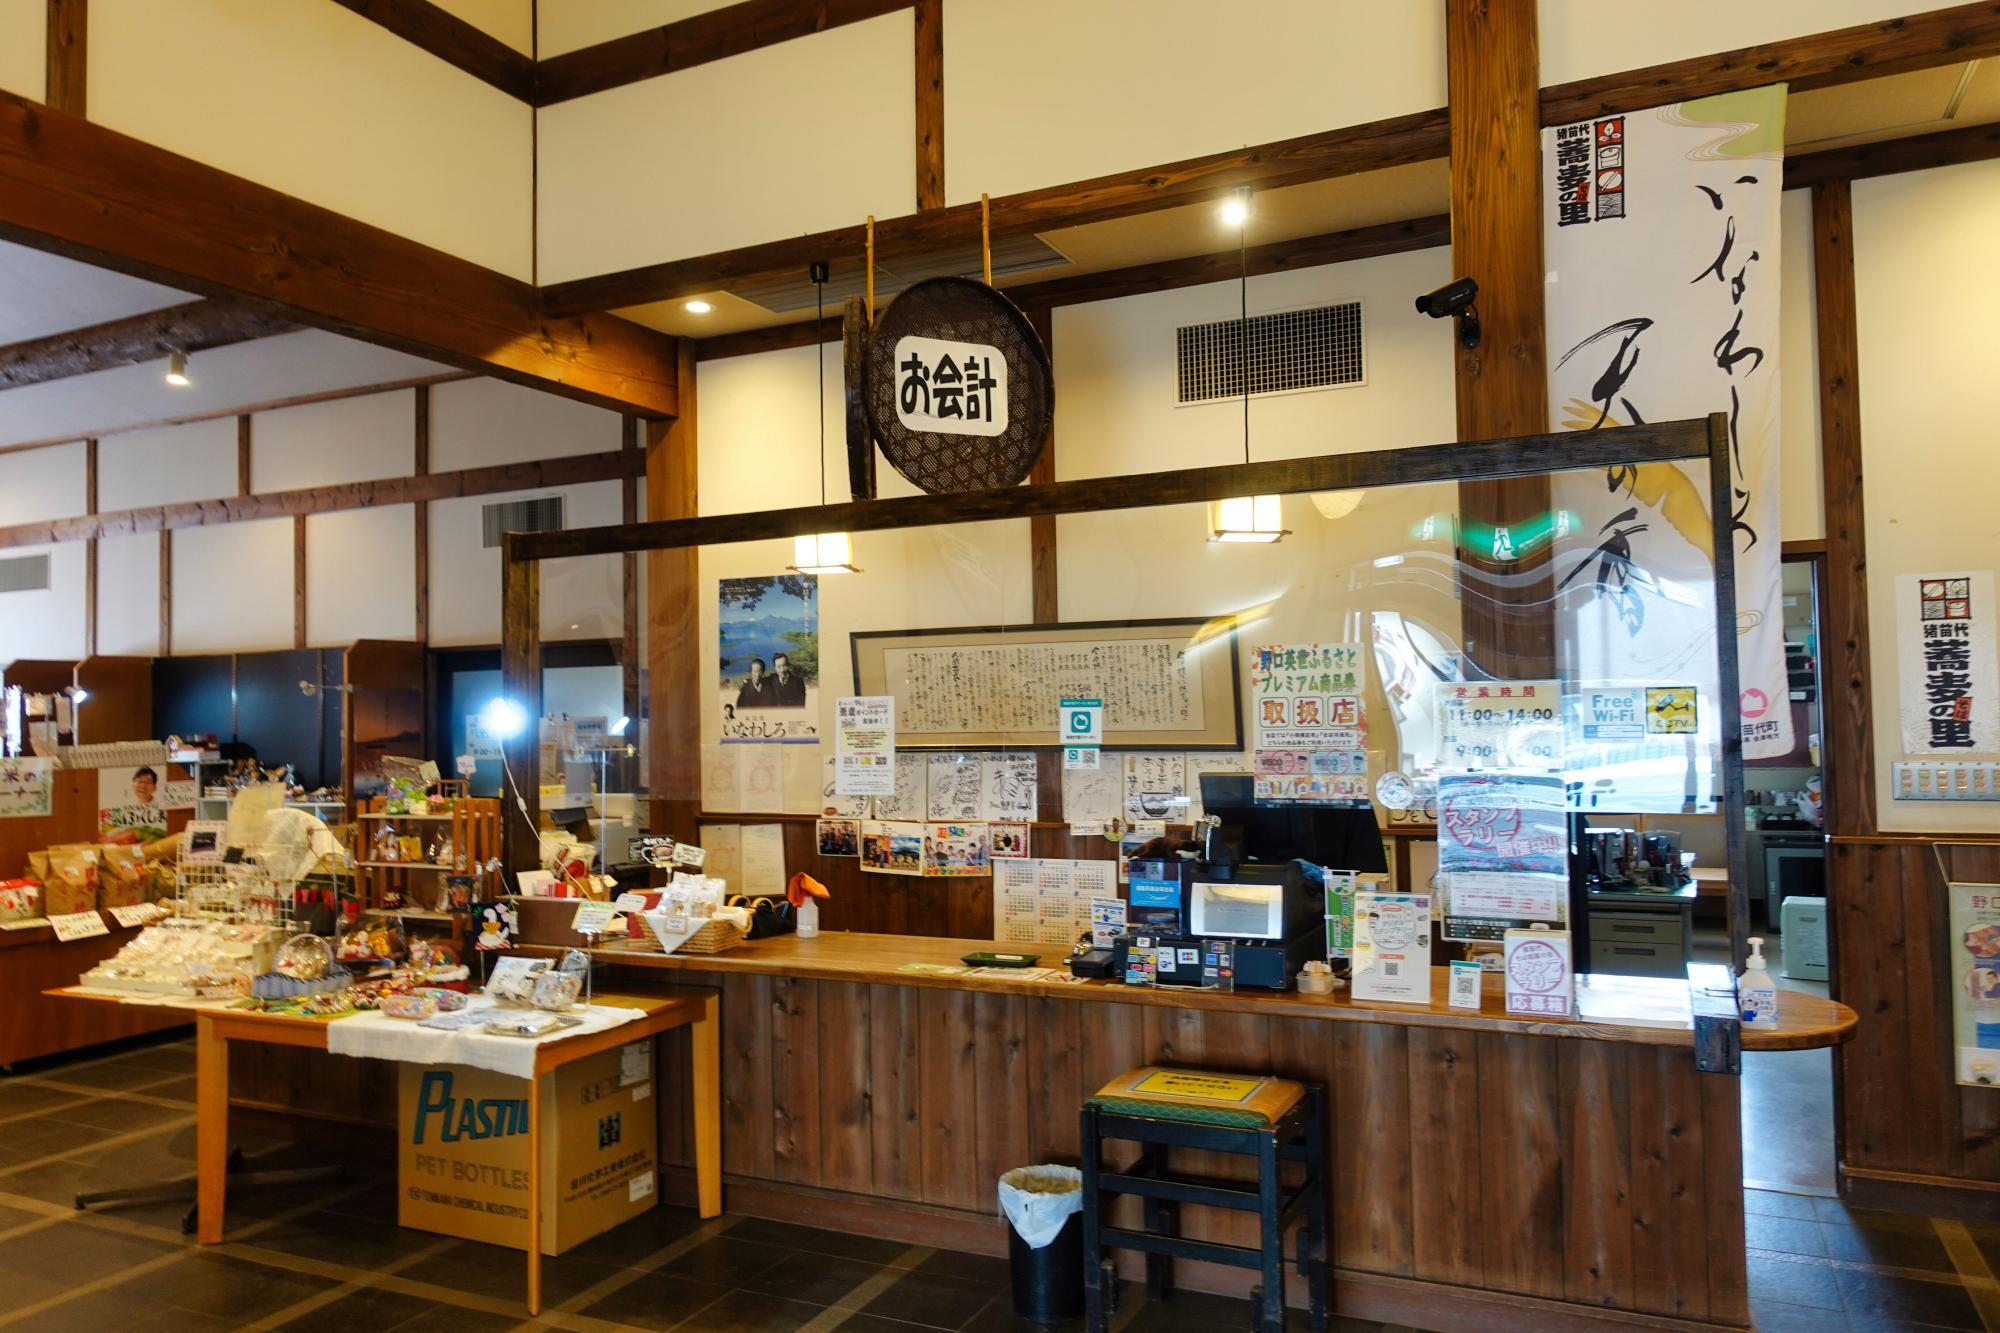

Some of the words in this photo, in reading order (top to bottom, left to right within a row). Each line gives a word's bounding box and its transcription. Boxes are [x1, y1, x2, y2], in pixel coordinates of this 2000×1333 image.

[1557, 124, 1590, 140] 猪苗代
[900, 352, 997, 423] お会計
[1923, 623, 1969, 638] 猪苗代
[1260, 648, 1357, 671] 野口英世ふるさと
[1260, 673, 1357, 693] プレミアム商品券
[1455, 685, 1536, 698] 営業時間
[1592, 694, 1633, 708] Free
[1924, 639, 1975, 748] 蕎麦の里
[1262, 699, 1355, 725] 取扱店
[1592, 709, 1635, 722] Wi-Fi
[723, 721, 786, 738] いなわしろ
[1742, 720, 1778, 735] 苗代町
[1456, 826, 1516, 846] ラリー
[416, 1153, 446, 1176] PET
